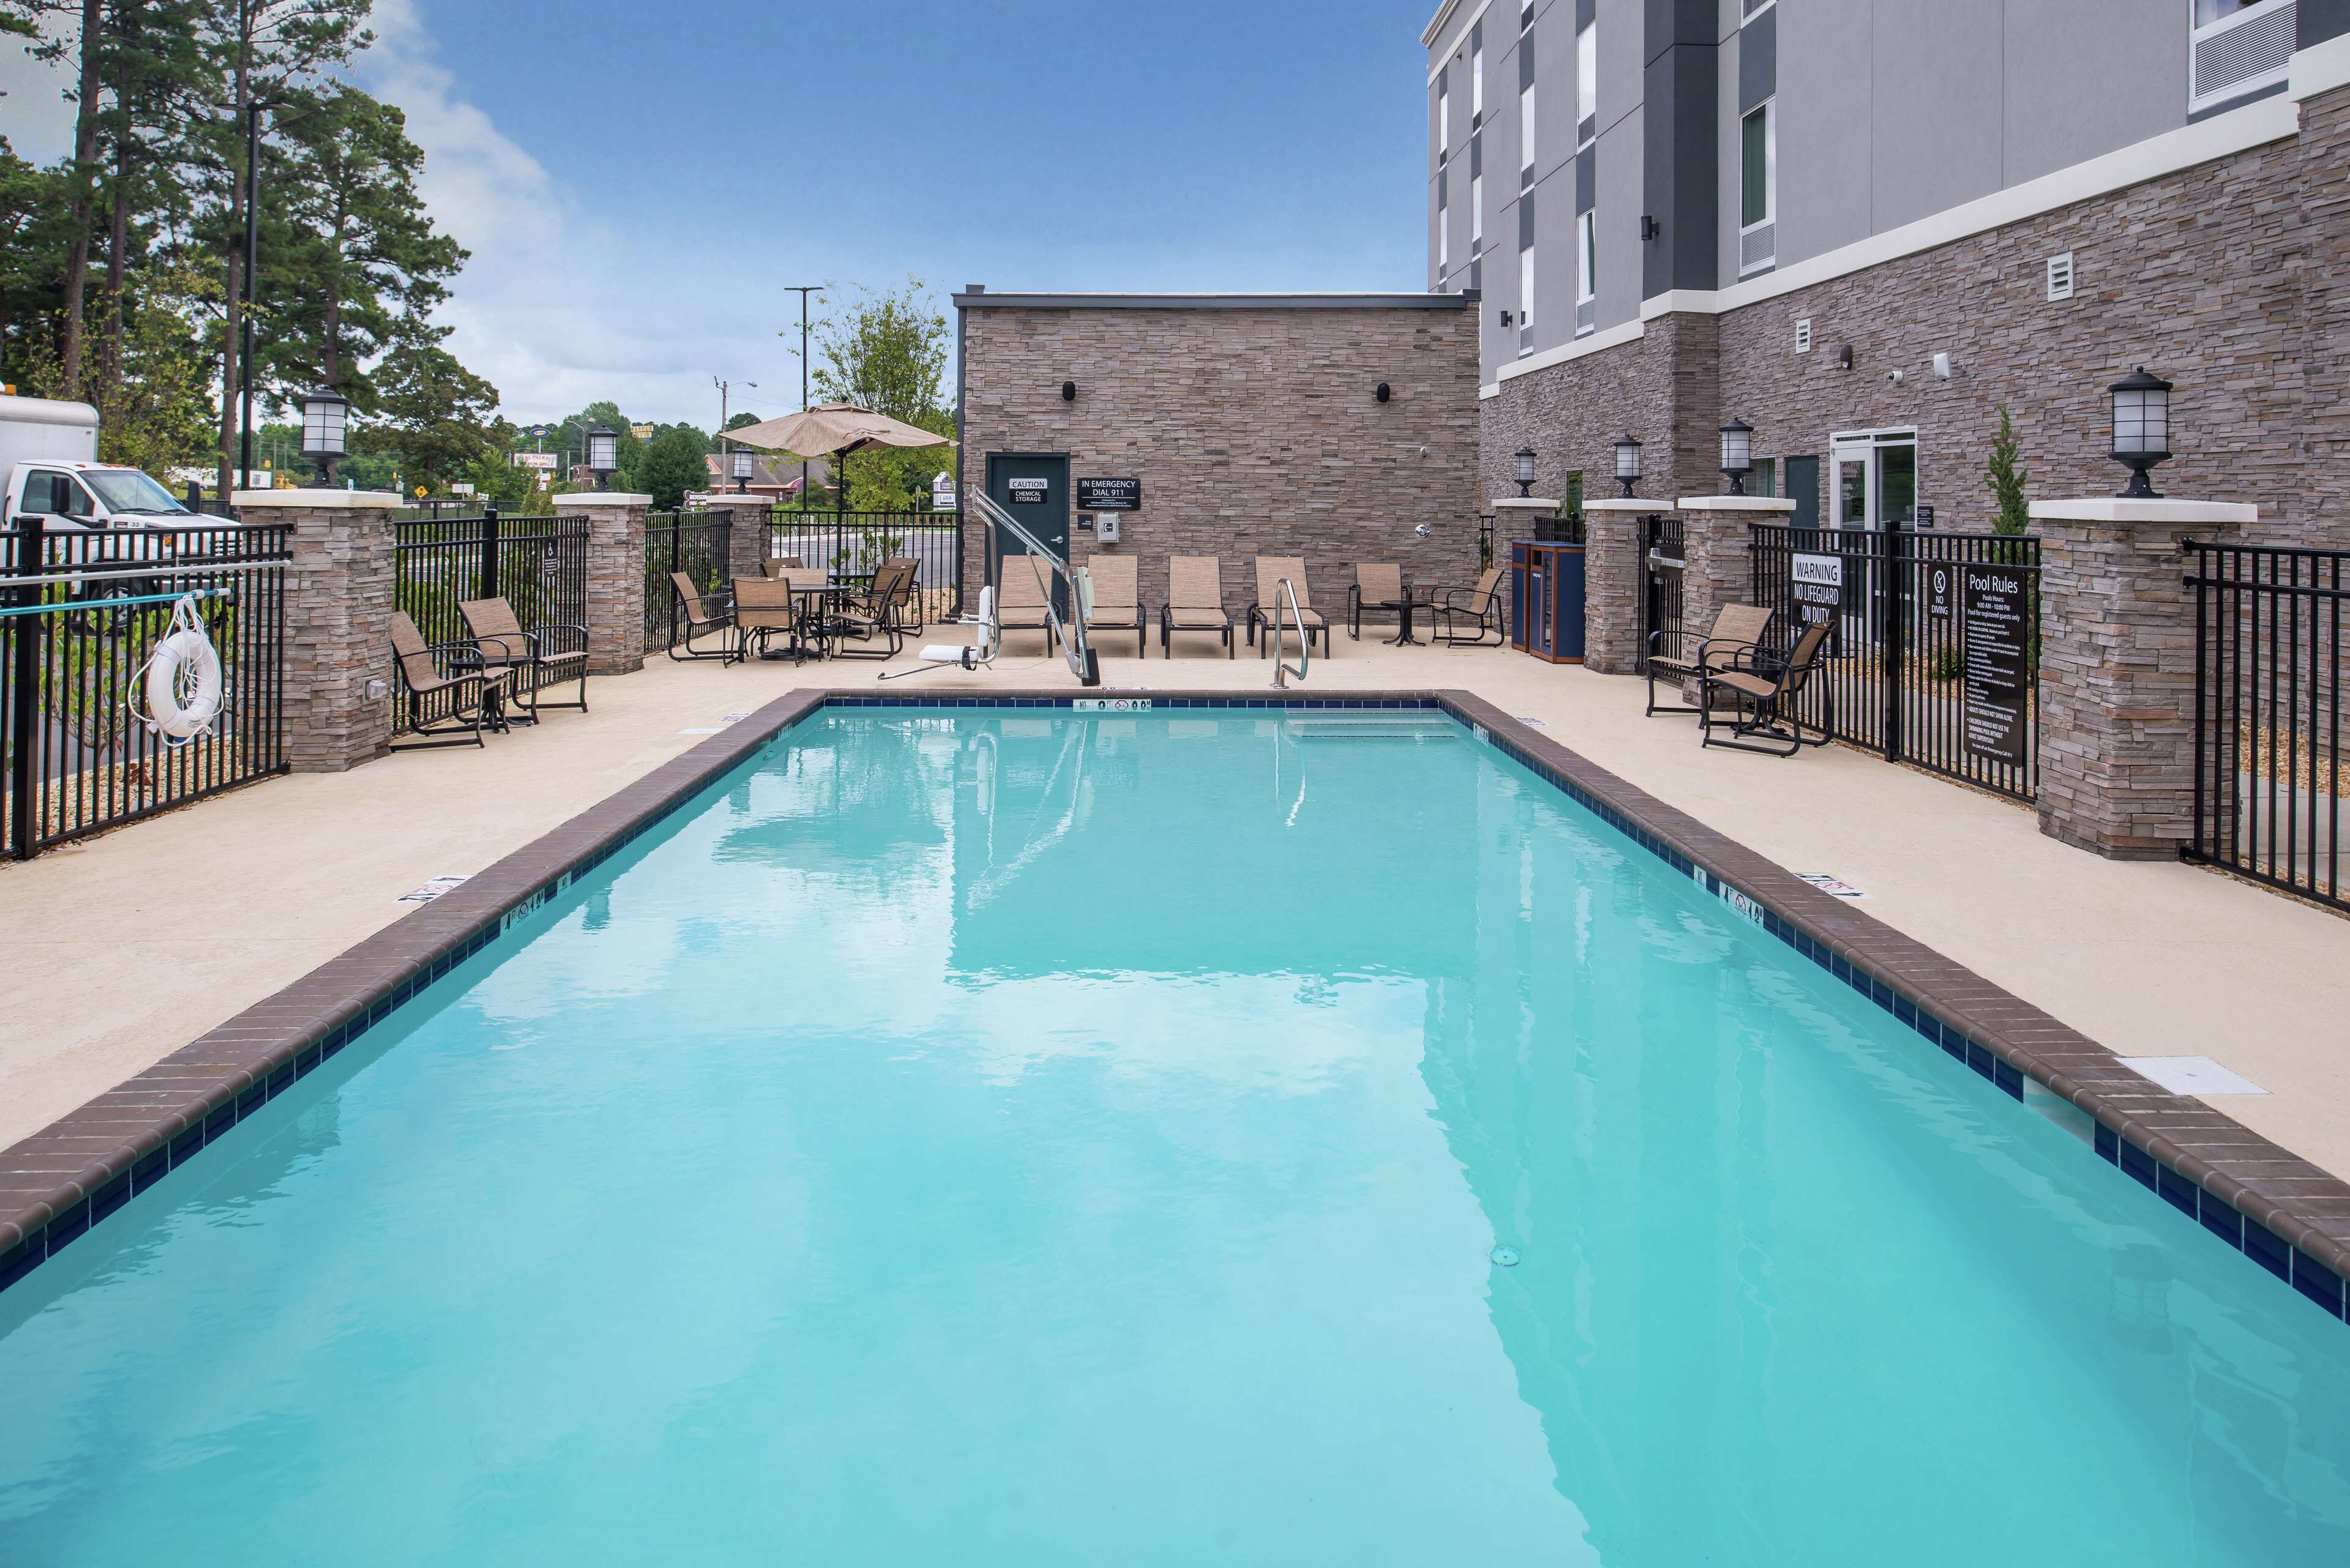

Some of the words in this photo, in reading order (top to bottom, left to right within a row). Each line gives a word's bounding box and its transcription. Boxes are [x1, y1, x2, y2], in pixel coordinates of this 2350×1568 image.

[1796, 561, 1838, 581] WARNING
[1970, 574, 1989, 591] Pool
[1993, 576, 2017, 593] Rules
[1794, 583, 1803, 600] NO
[1804, 584, 1839, 605] LIFEGUARD
[1936, 595, 1944, 604] NO
[1802, 605, 1811, 622] ON
[1813, 607, 1830, 623] DUTY
[1931, 605, 1948, 615] DIVING
[1969, 725, 1983, 733] SWIMMING
[1977, 734, 1994, 744] SUPERVISION
[1988, 747, 2002, 755] Emergency
